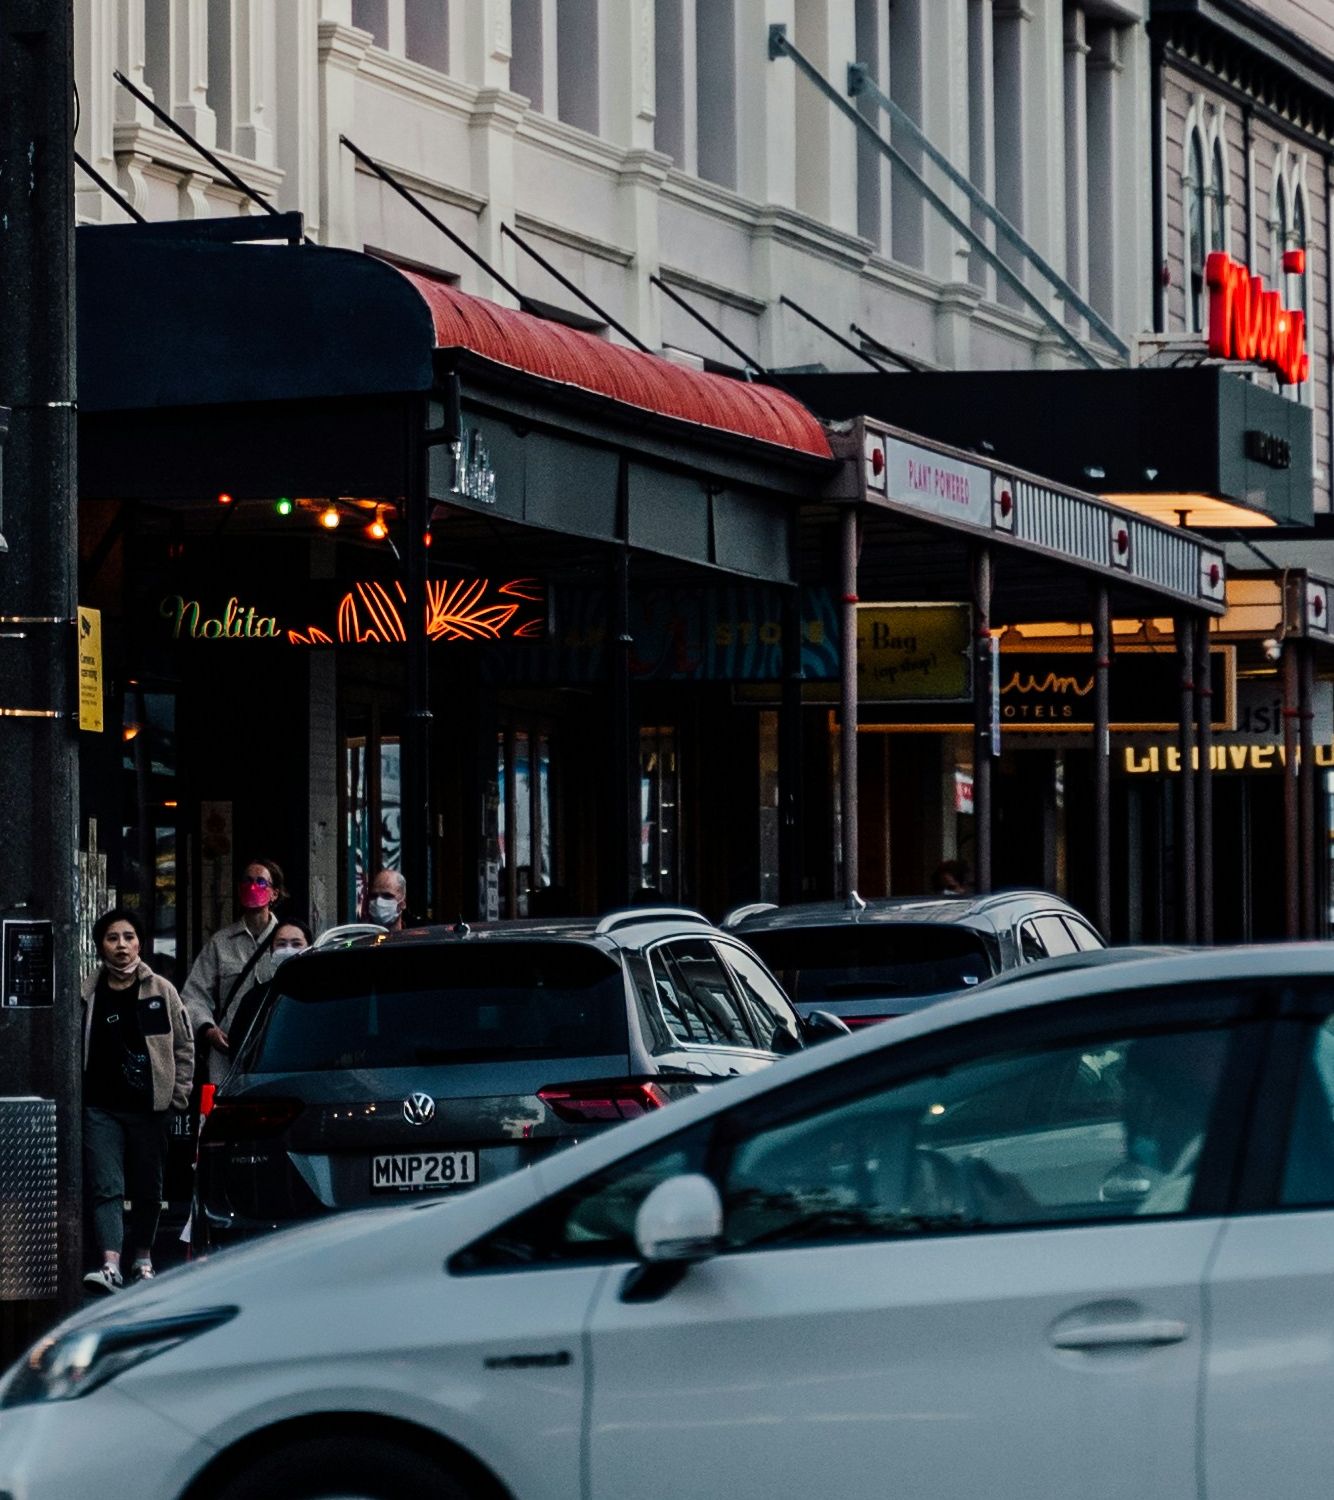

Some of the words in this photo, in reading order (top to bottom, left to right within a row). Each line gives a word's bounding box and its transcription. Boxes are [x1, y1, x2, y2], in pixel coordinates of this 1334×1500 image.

[908, 459, 931, 495] PLANT
[934, 468, 970, 505] POWERED
[159, 595, 281, 639] Nolita
[1003, 704, 1073, 718] OTELS
[375, 1154, 470, 1185] MNP281
